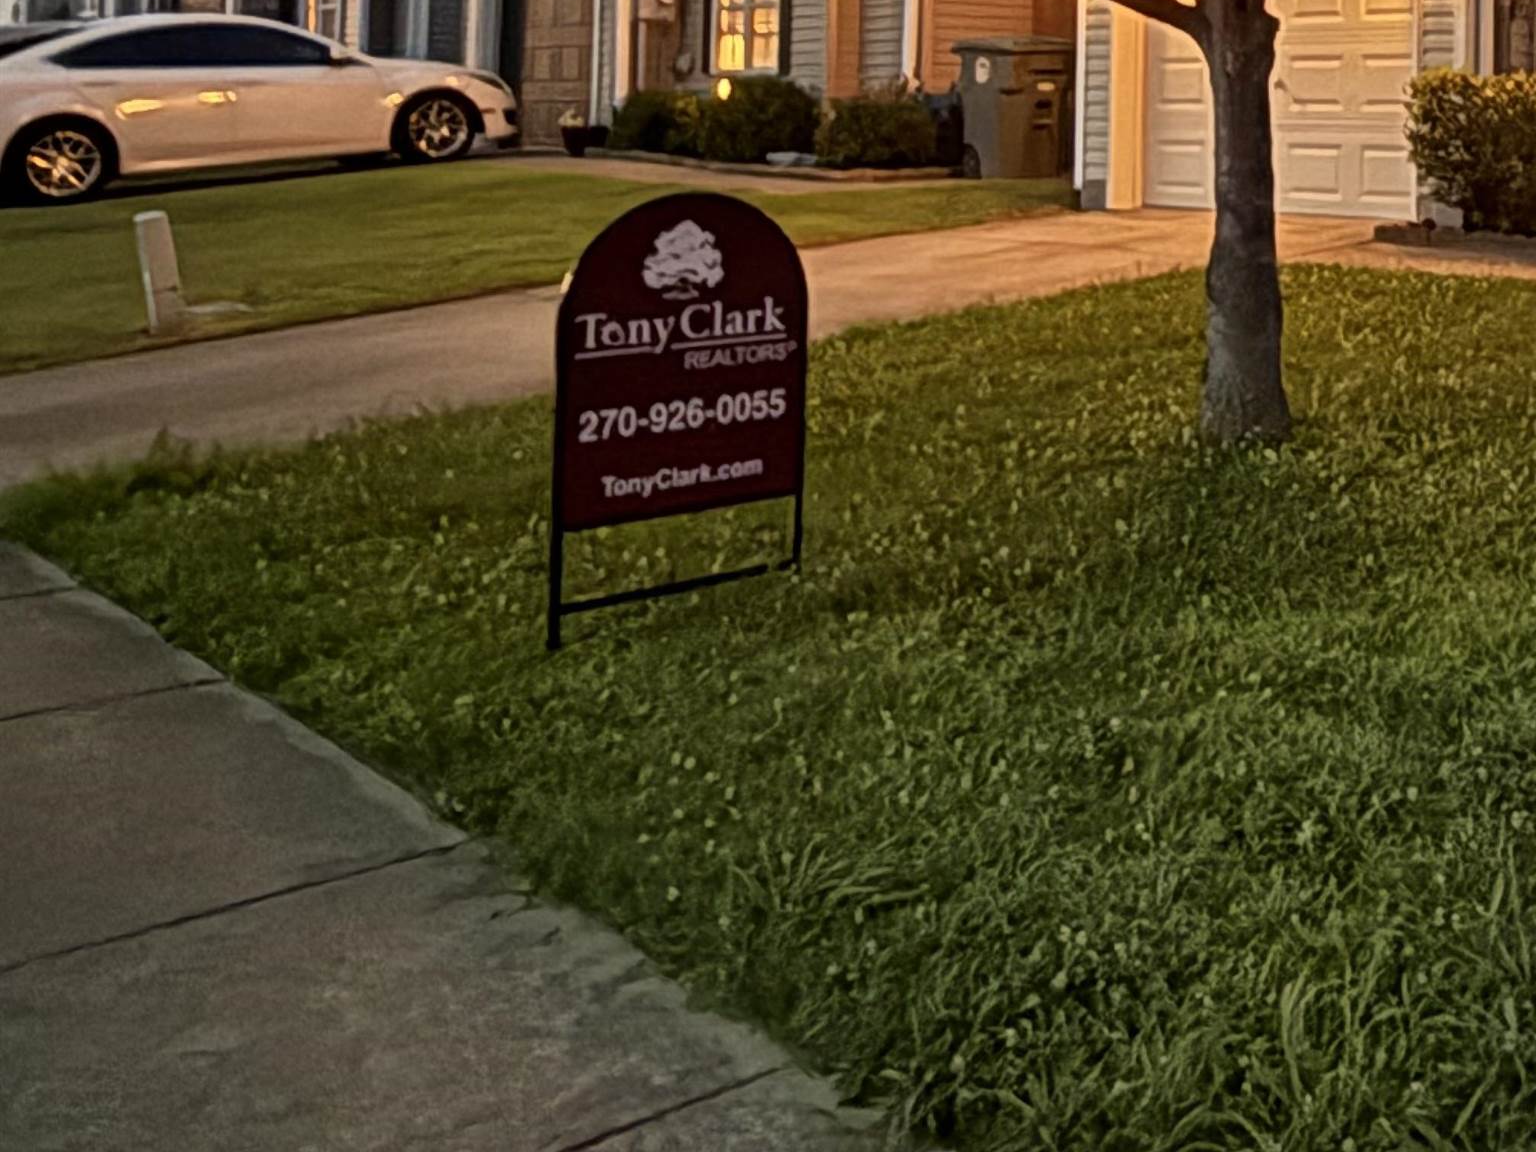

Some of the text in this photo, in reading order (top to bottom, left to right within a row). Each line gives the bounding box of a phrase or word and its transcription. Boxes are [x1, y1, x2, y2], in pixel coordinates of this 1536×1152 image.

[574, 295, 787, 355] Tony Clark
[577, 387, 787, 443] 270-926-0055
[600, 458, 764, 498] TonyClark.com
